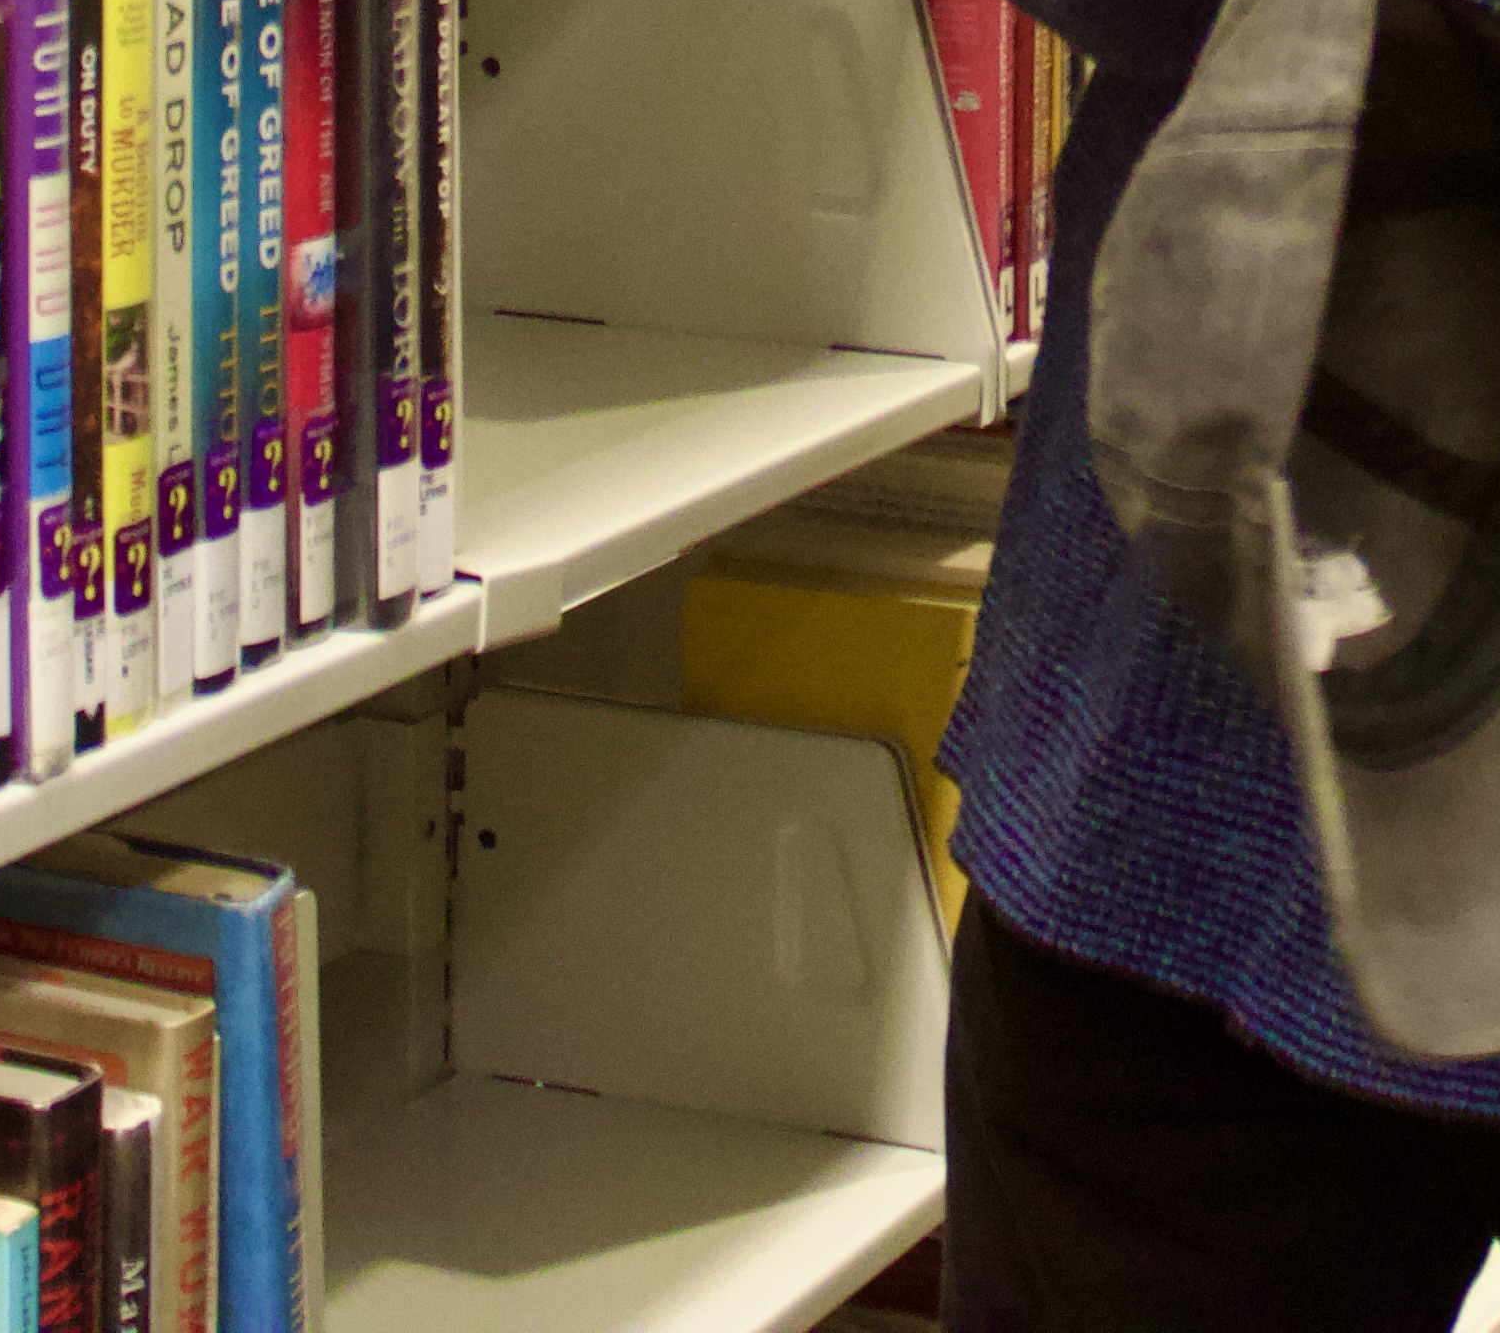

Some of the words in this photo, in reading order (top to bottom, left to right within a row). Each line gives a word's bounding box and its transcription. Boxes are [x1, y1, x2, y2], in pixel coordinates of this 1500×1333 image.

[80, 43, 98, 92] ON
[219, 47, 240, 111] OF
[257, 24, 282, 90] OF
[437, 20, 452, 147] DOLLAR
[79, 95, 99, 176] DUTY
[107, 127, 137, 259] MURDER
[163, 98, 186, 256] DROP
[257, 107, 282, 270] GREED
[437, 158, 452, 221] POP
[218, 131, 241, 294] GREED
[166, 321, 180, 432] James
[180, 1035, 213, 1183] WAR
[38, 1180, 84, 1333] RAN
